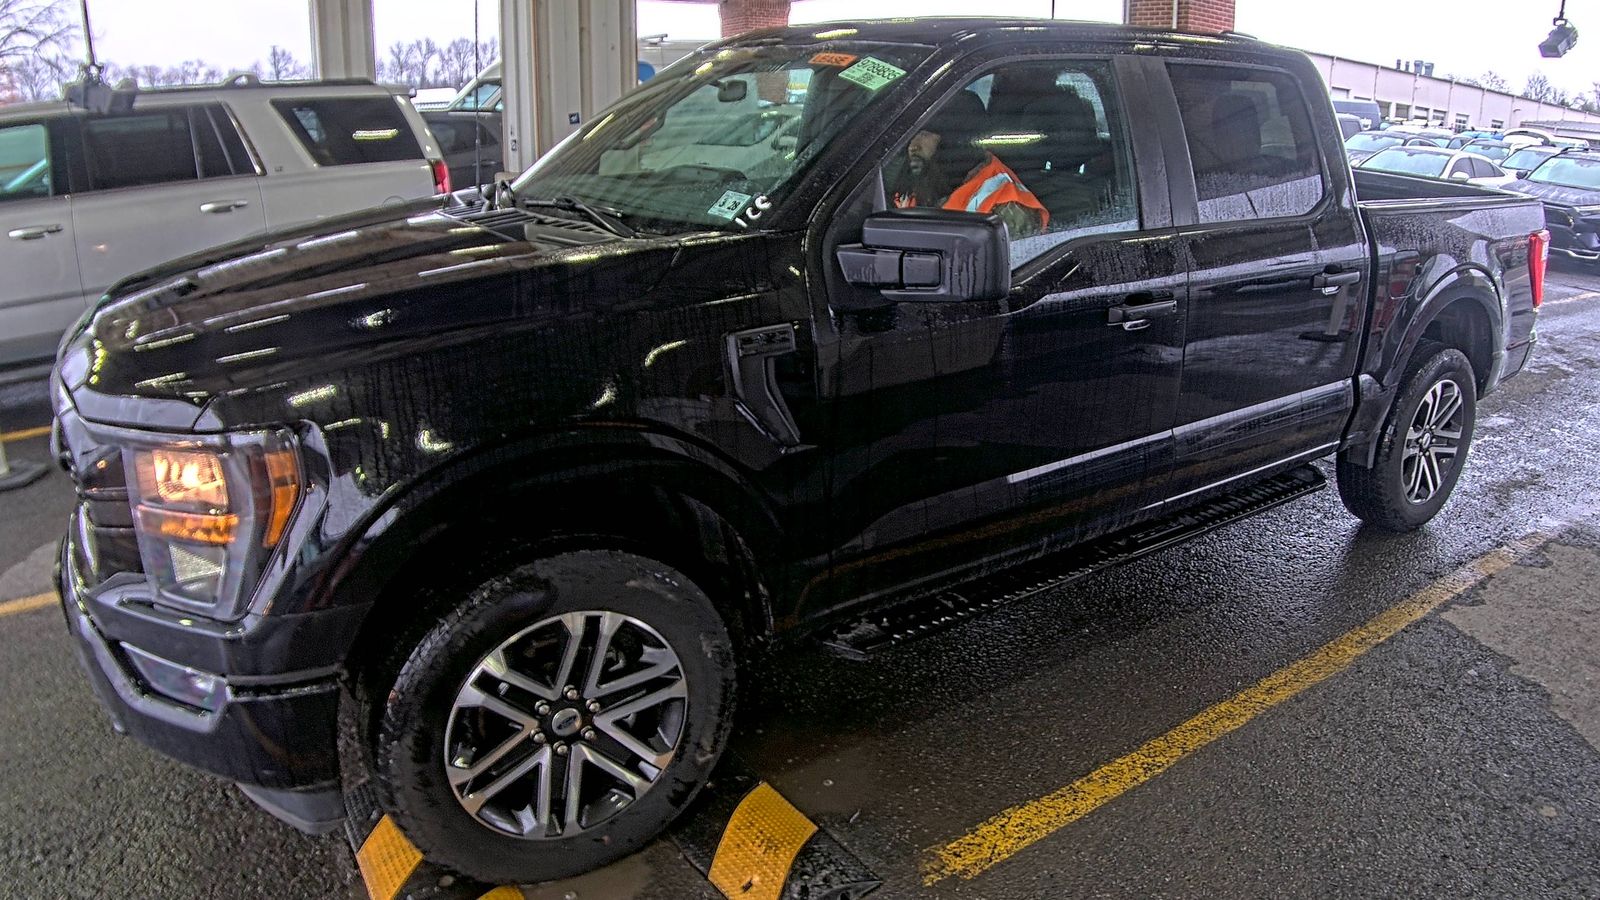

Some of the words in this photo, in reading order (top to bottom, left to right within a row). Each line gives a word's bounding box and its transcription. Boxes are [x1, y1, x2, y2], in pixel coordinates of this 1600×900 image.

[812, 54, 849, 65] LEASE
[718, 198, 727, 208] 3
[727, 200, 741, 211] 28
